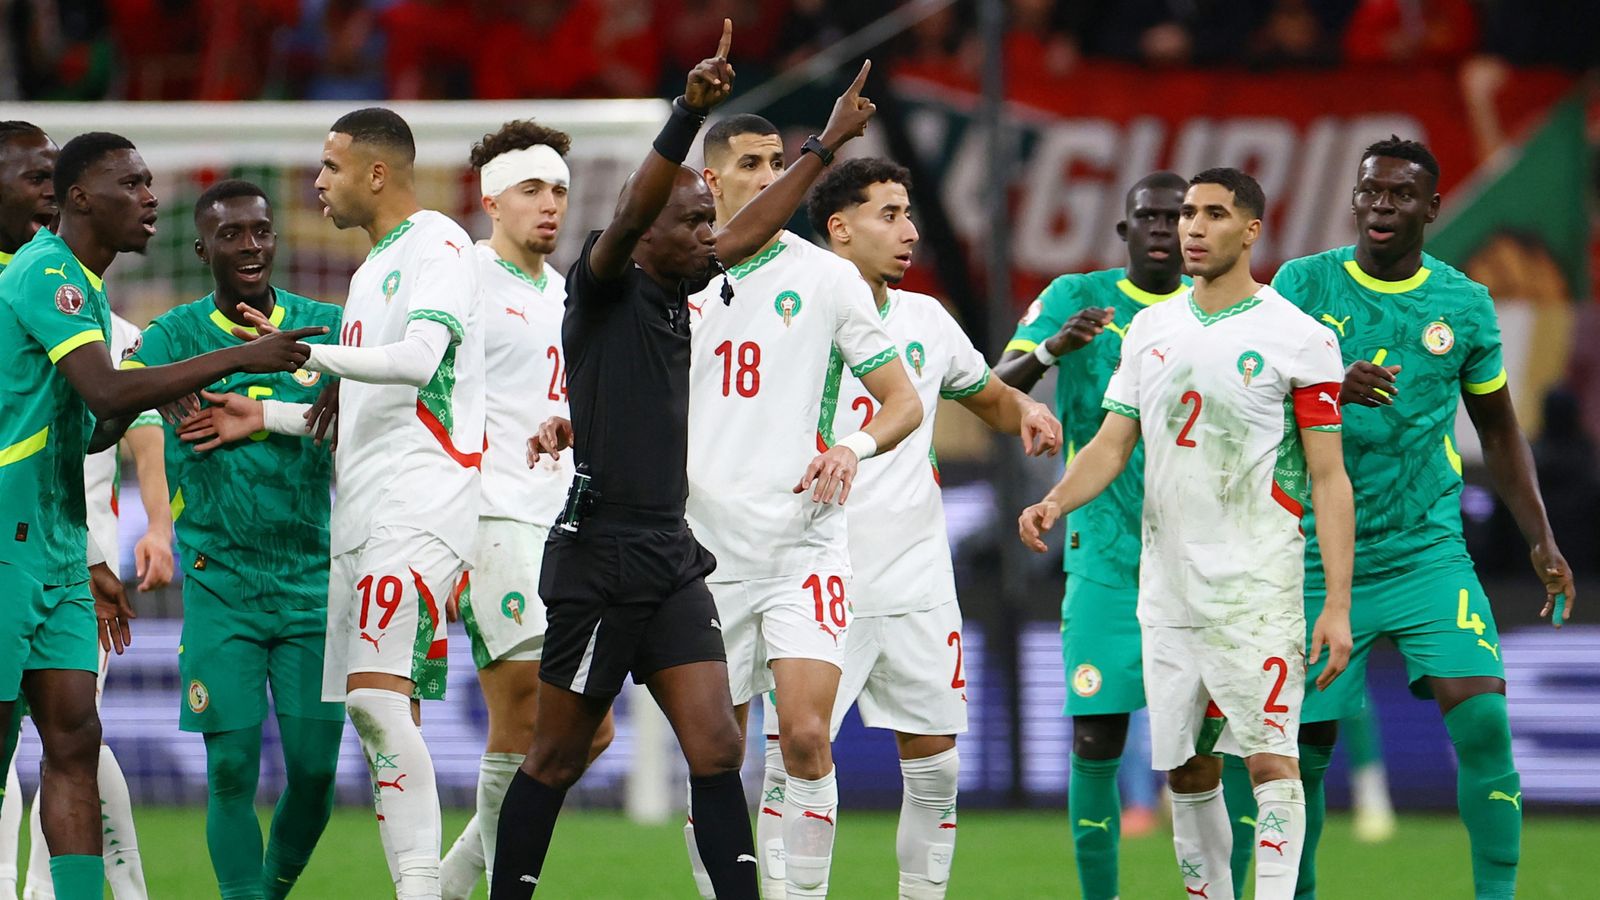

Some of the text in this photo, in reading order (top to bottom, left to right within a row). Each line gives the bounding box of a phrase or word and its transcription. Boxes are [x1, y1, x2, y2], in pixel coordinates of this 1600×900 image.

[713, 340, 762, 398] 18
[1175, 390, 1203, 448] 2
[356, 574, 404, 630] 19
[801, 573, 847, 628] 18
[1456, 588, 1487, 636] 4
[1262, 655, 1290, 714] 2
